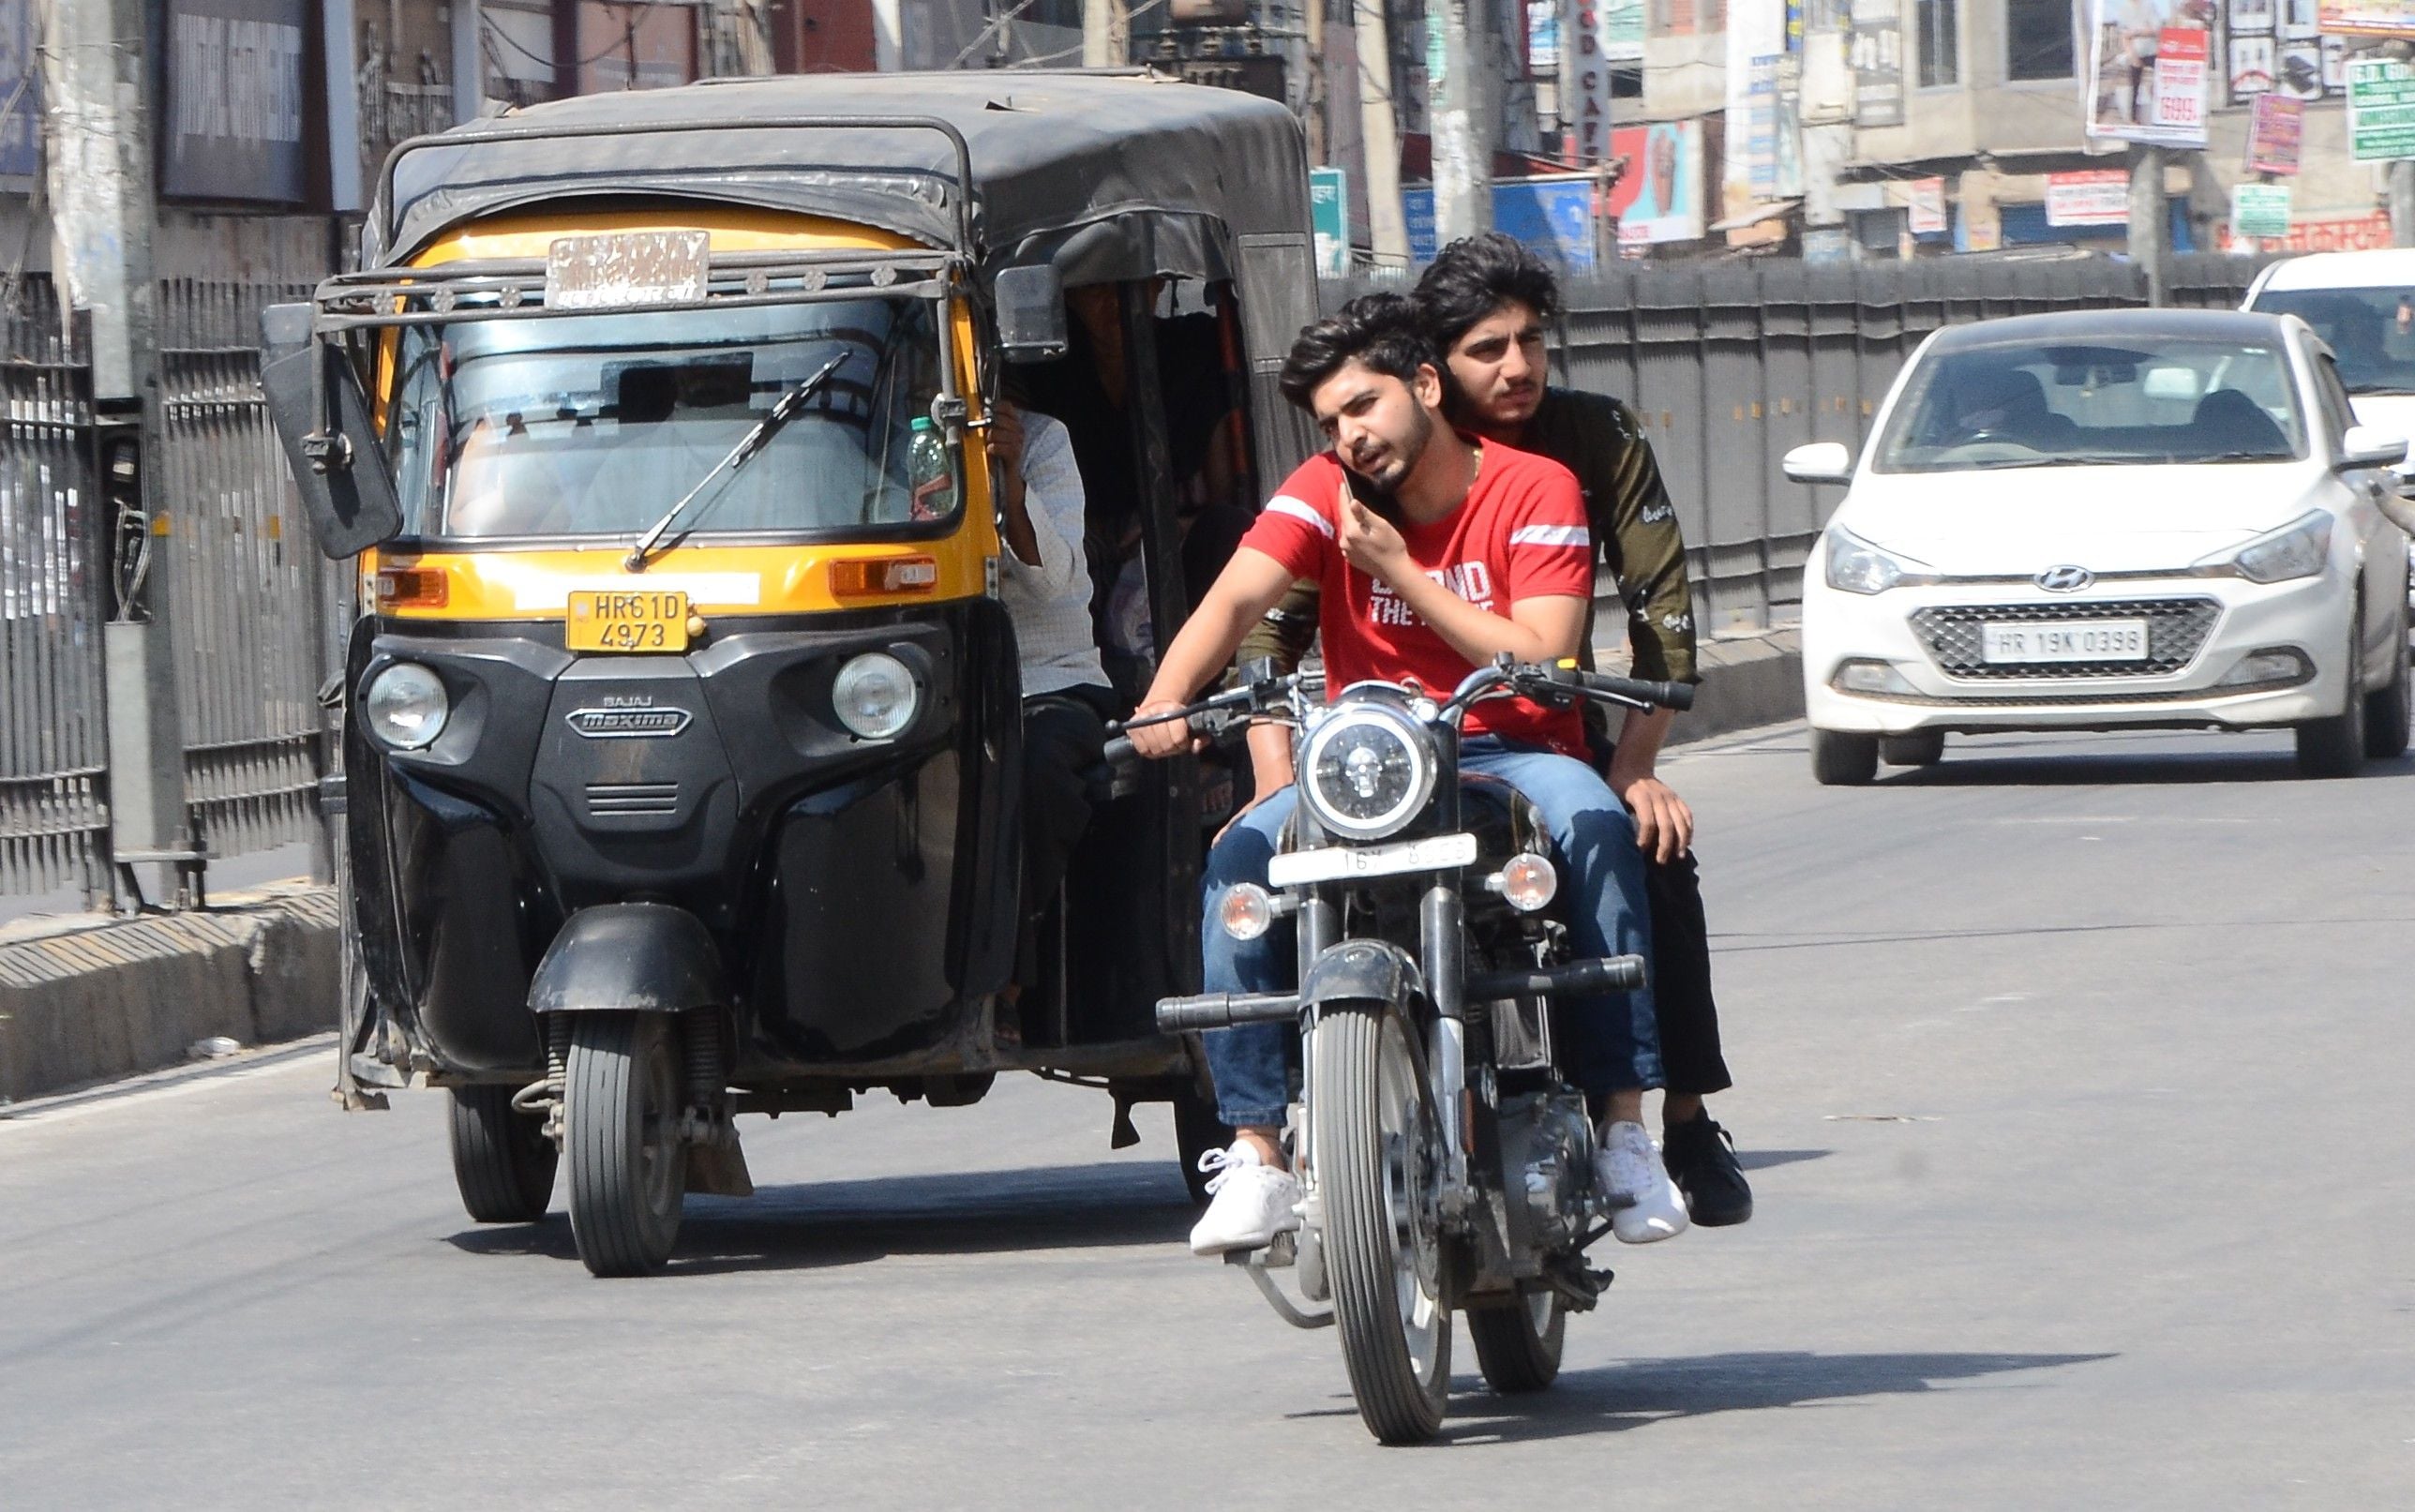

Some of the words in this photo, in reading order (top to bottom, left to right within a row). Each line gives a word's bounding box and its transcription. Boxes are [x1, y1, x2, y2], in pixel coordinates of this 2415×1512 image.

[595, 594, 679, 620] HR61D
[600, 623, 665, 647] 4973
[2000, 633, 2025, 655] HR
[604, 696, 652, 707] BAJAJ
